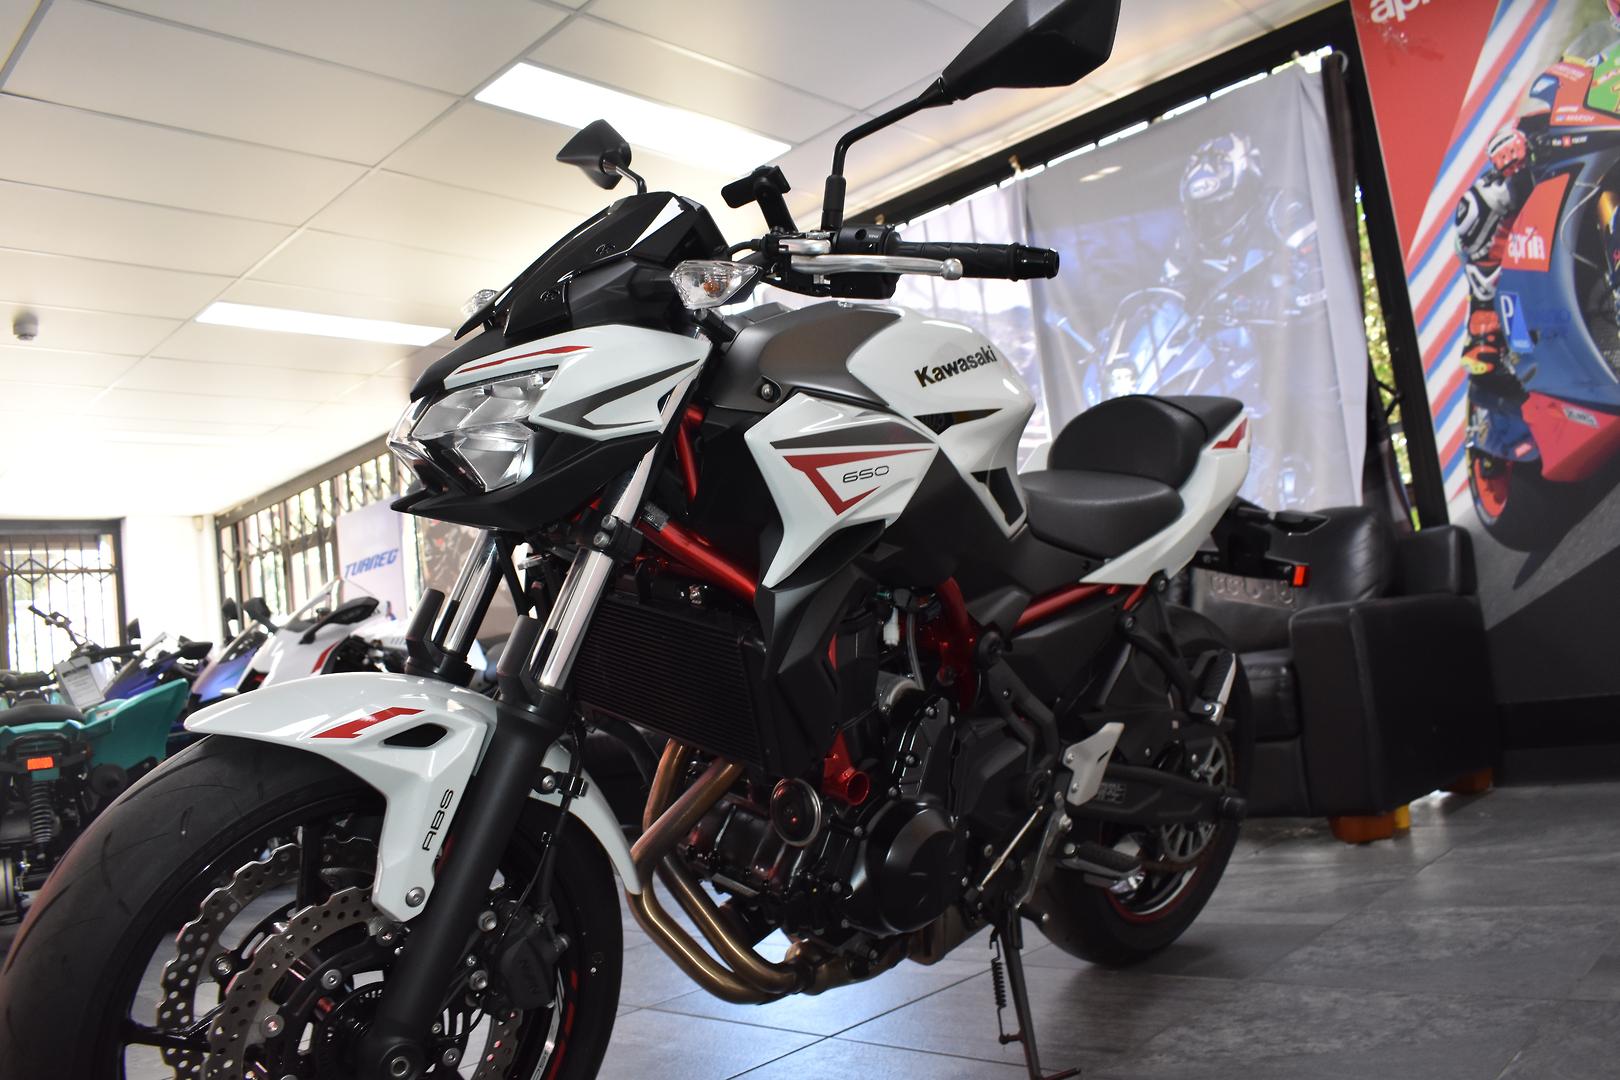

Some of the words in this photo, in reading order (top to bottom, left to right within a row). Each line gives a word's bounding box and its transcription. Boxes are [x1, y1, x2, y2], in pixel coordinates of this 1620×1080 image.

[914, 345, 997, 388] Kawasaki
[842, 465, 890, 483] 650
[422, 788, 454, 851] ABS
